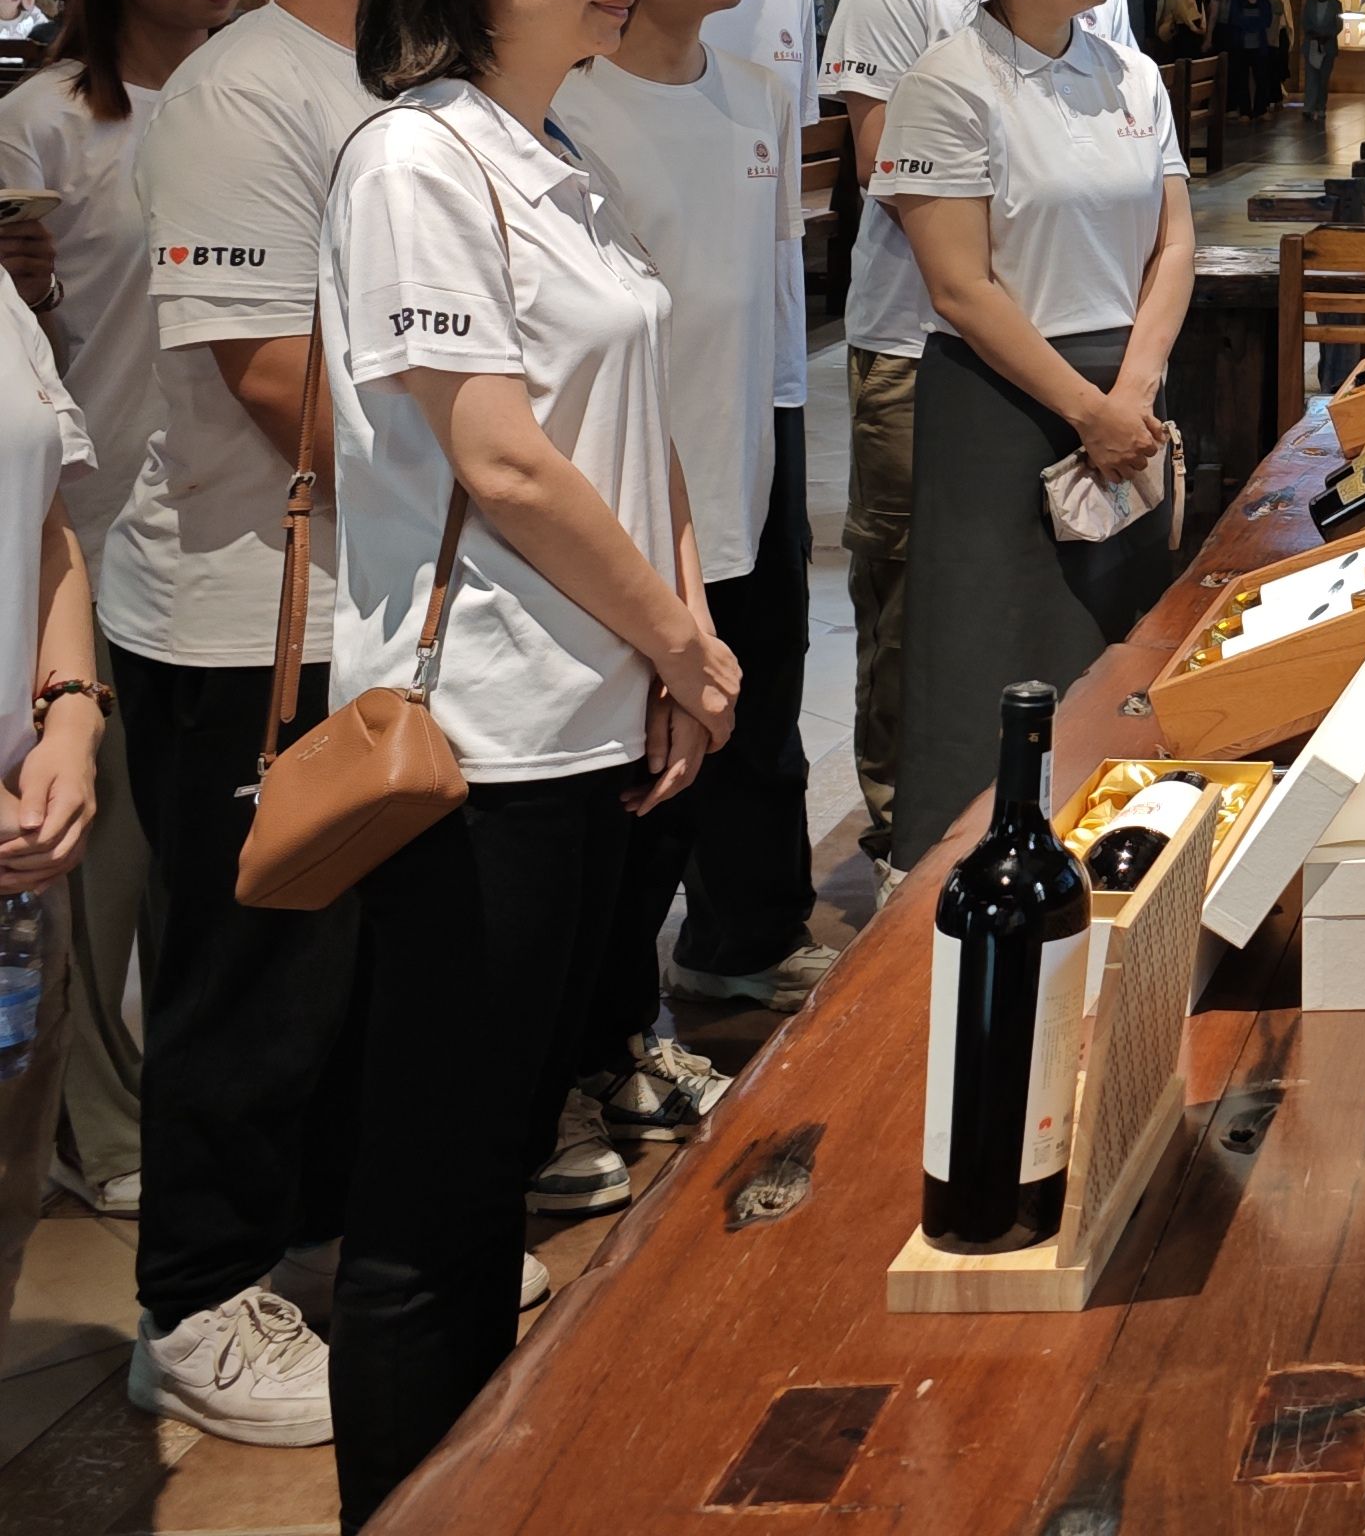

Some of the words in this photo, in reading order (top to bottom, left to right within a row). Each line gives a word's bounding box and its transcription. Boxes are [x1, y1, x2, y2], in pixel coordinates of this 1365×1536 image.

[825, 62, 832, 75] I
[841, 59, 878, 76] TBU
[896, 158, 934, 175] TBU
[157, 247, 167, 265] I
[192, 246, 266, 267] BTBU
[401, 307, 471, 337] BTBU
